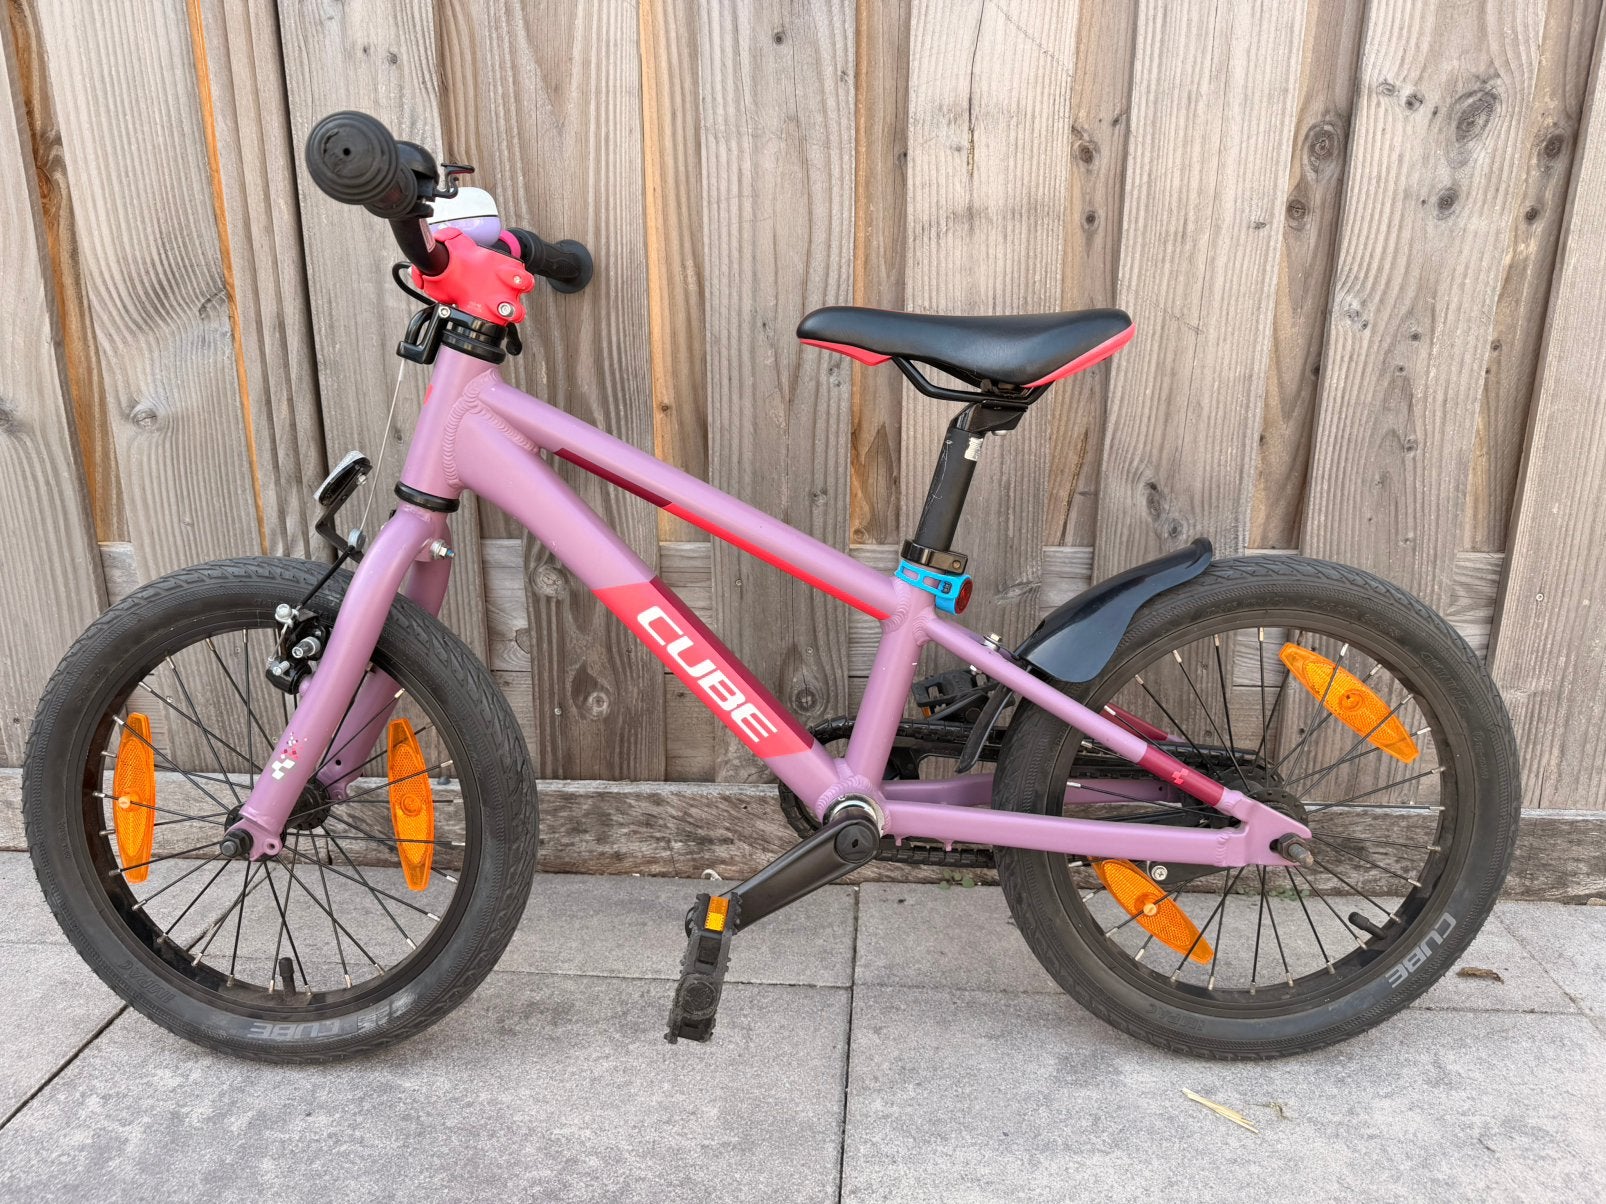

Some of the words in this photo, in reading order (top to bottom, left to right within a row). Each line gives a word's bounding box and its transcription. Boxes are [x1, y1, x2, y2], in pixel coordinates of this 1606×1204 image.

[637, 605, 778, 743] CUBE
[1385, 912, 1457, 989] CUBE
[247, 1019, 341, 1039] CUBE
